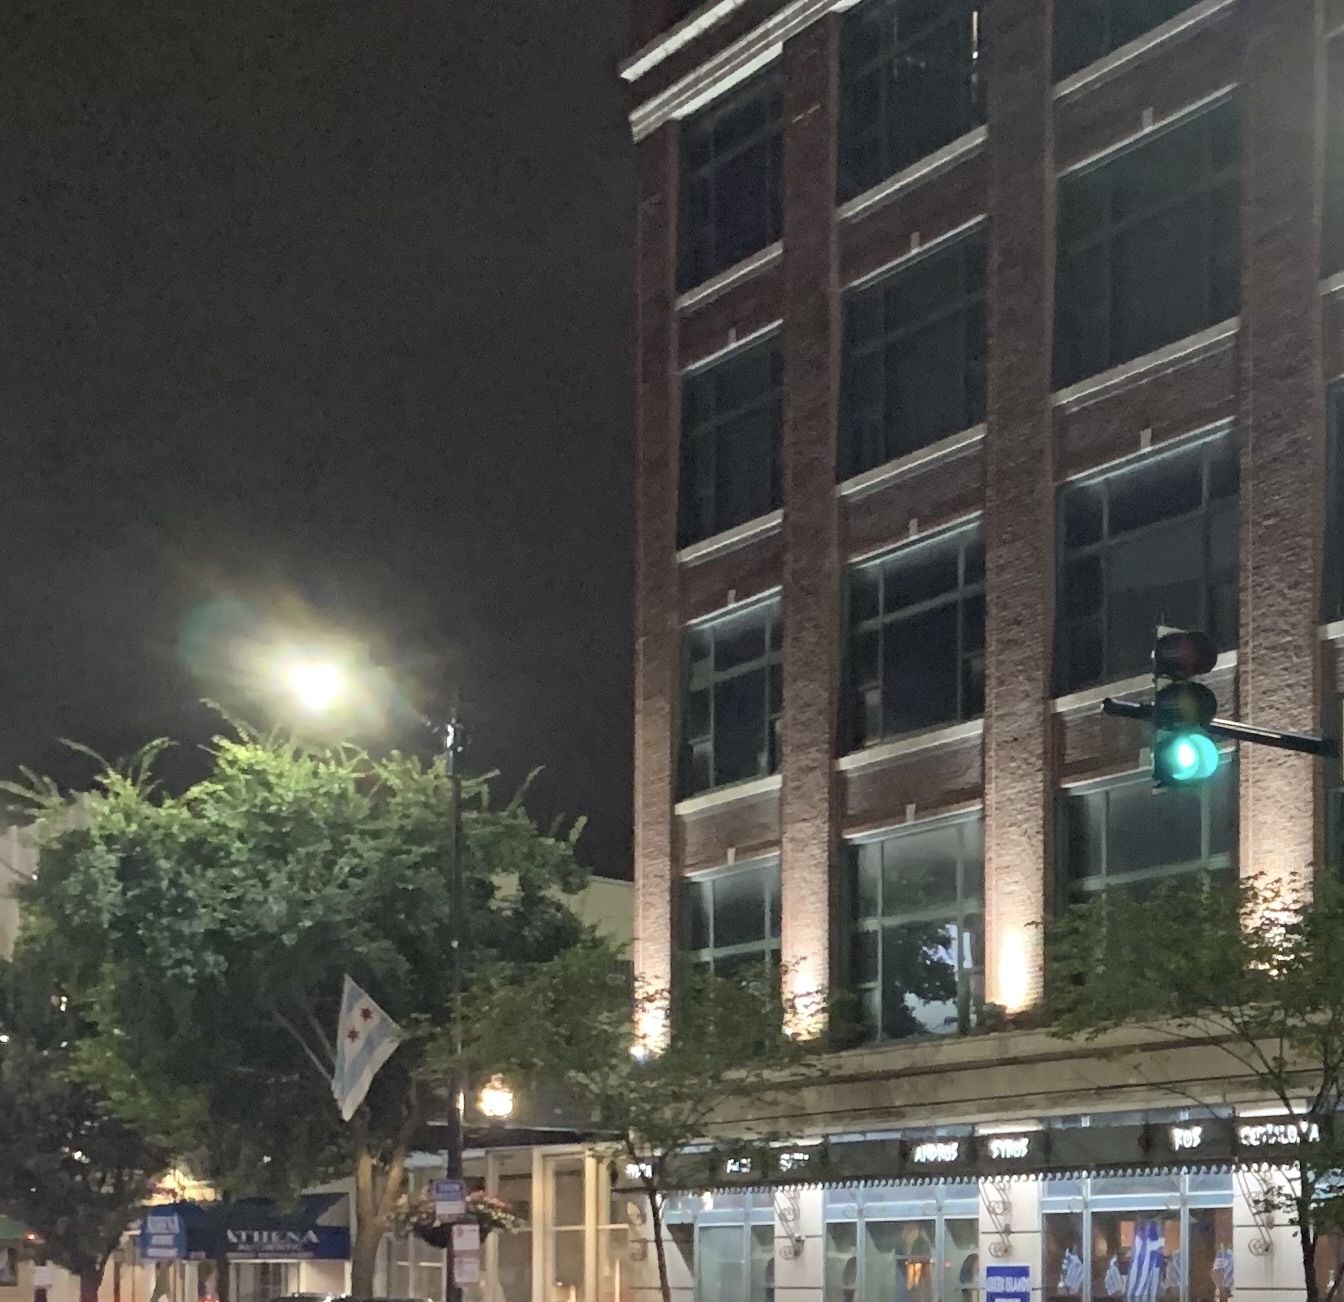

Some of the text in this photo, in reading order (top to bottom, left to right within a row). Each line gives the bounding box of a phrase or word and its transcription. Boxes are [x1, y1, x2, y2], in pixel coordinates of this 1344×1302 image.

[914, 1141, 959, 1162] ANDROS
[989, 1137, 1030, 1159] SYROS
[226, 1228, 320, 1244] ATHENA
